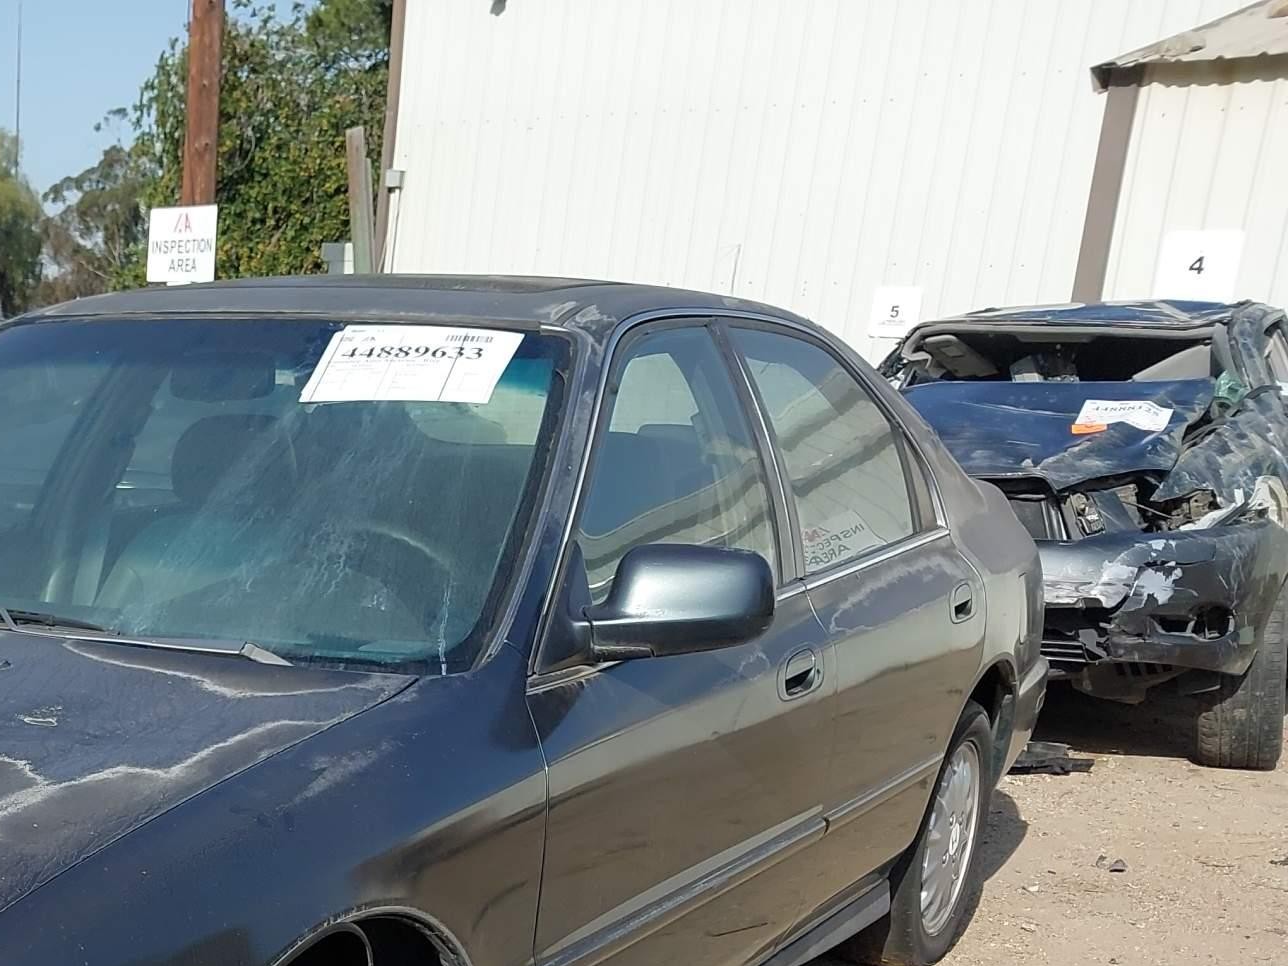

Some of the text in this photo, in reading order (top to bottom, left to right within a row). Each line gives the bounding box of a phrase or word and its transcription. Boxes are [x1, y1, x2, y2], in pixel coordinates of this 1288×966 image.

[151, 239, 213, 254] INSPECTION
[168, 258, 197, 273] AREA
[1189, 256, 1204, 274] 4
[890, 305, 900, 318] 5
[341, 344, 485, 361] 44889633
